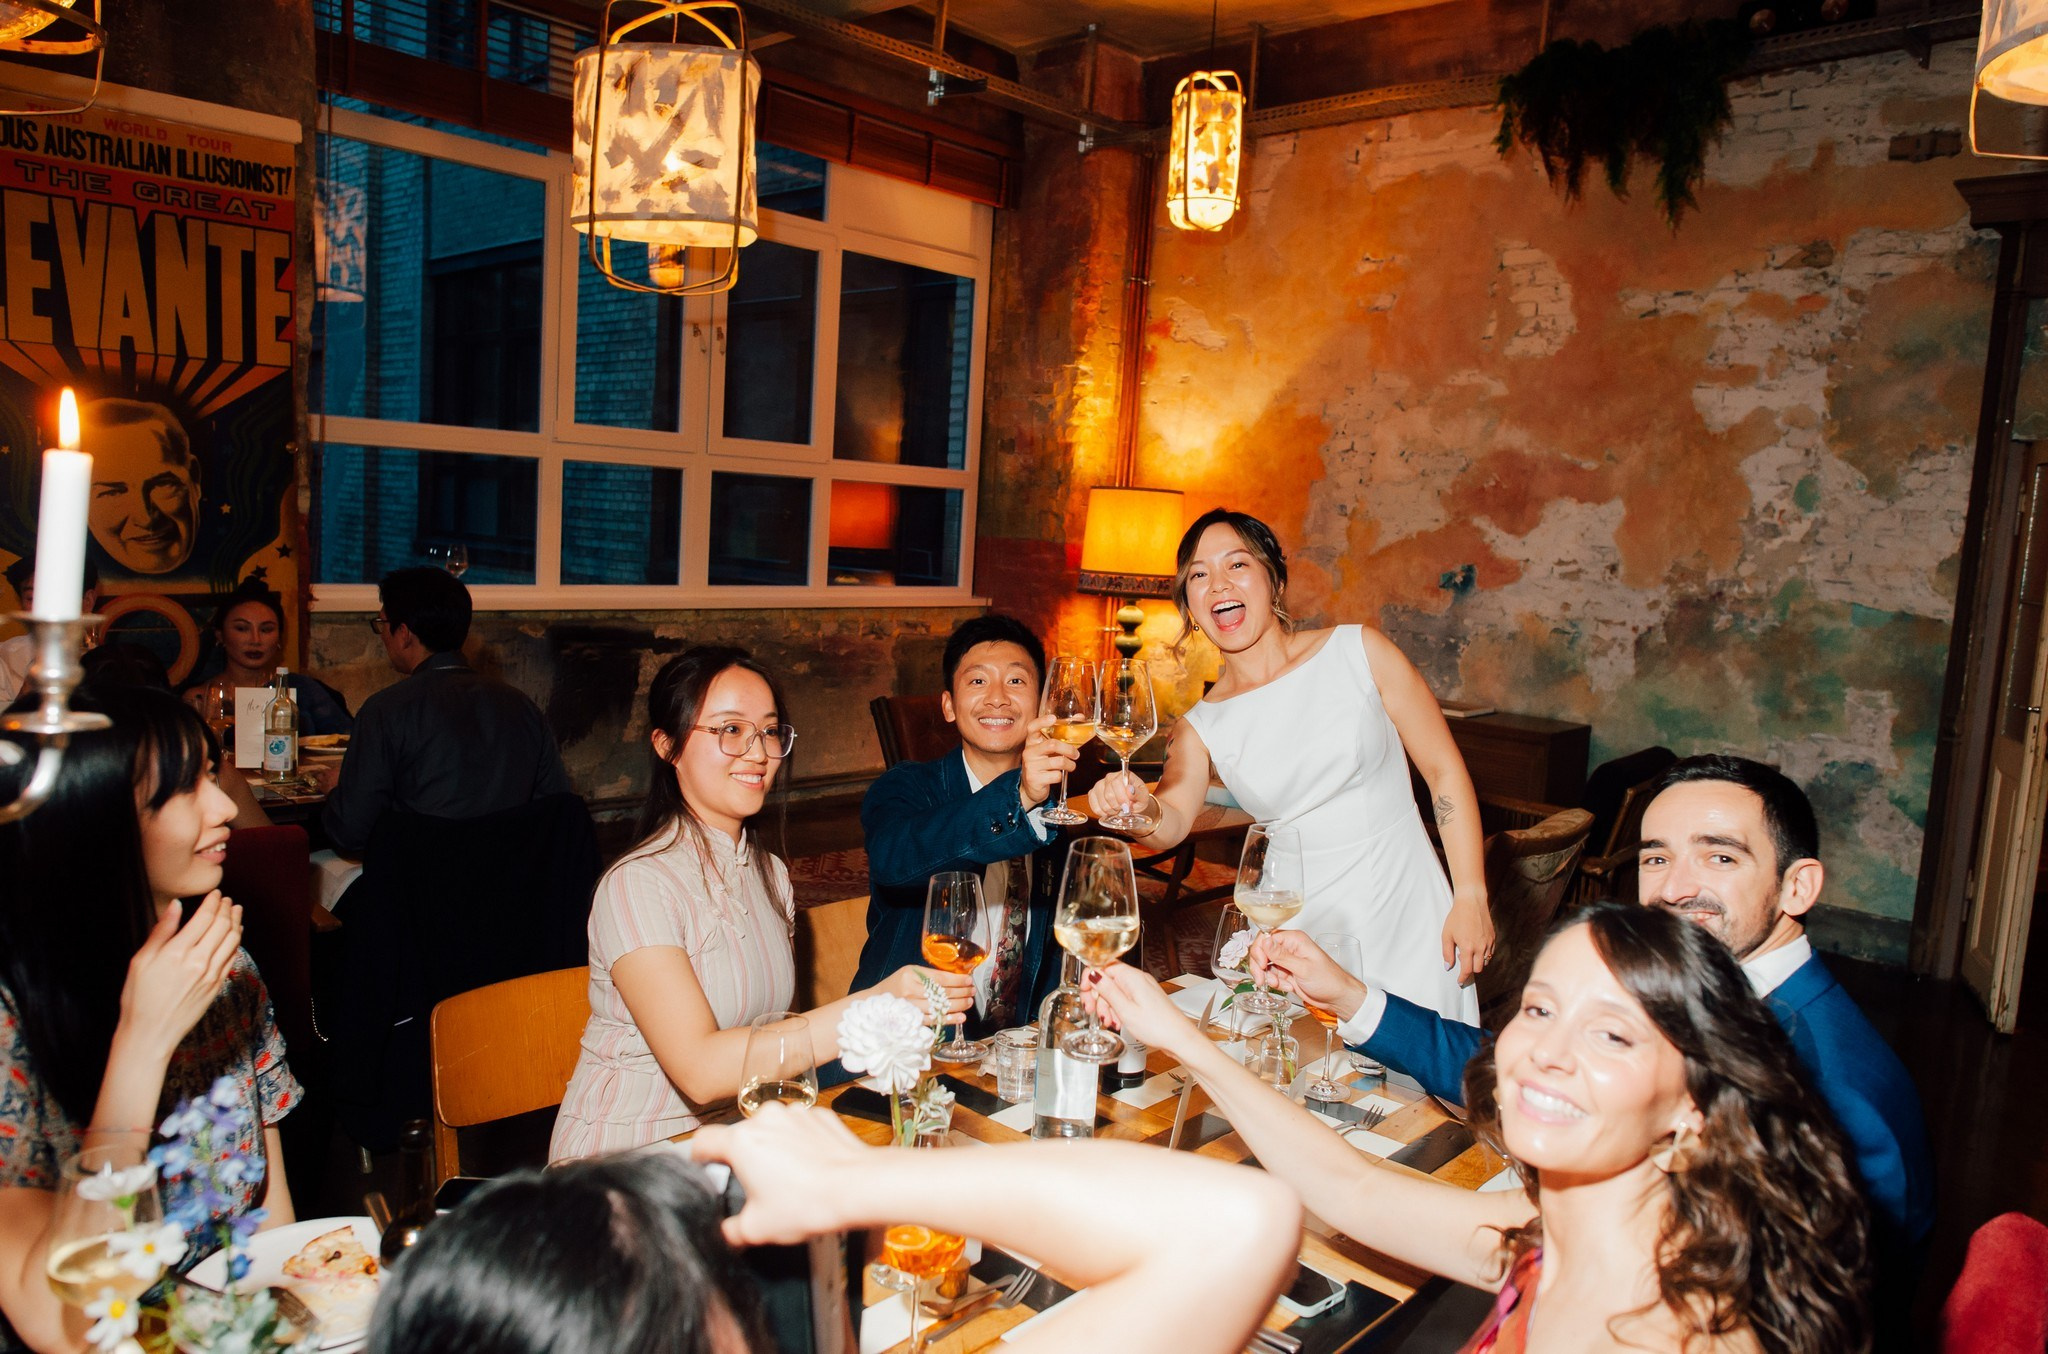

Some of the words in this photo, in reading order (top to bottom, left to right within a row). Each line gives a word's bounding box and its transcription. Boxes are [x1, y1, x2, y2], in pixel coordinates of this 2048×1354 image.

[44, 124, 171, 176] AUSTRALIAN
[177, 148, 292, 195] ILLUSIONIST!
[103, 118, 167, 141] WORLD
[187, 133, 232, 153] TOUR
[15, 158, 111, 194] THE
[133, 181, 276, 221] GREAT
[0, 188, 292, 367] EVANTE
